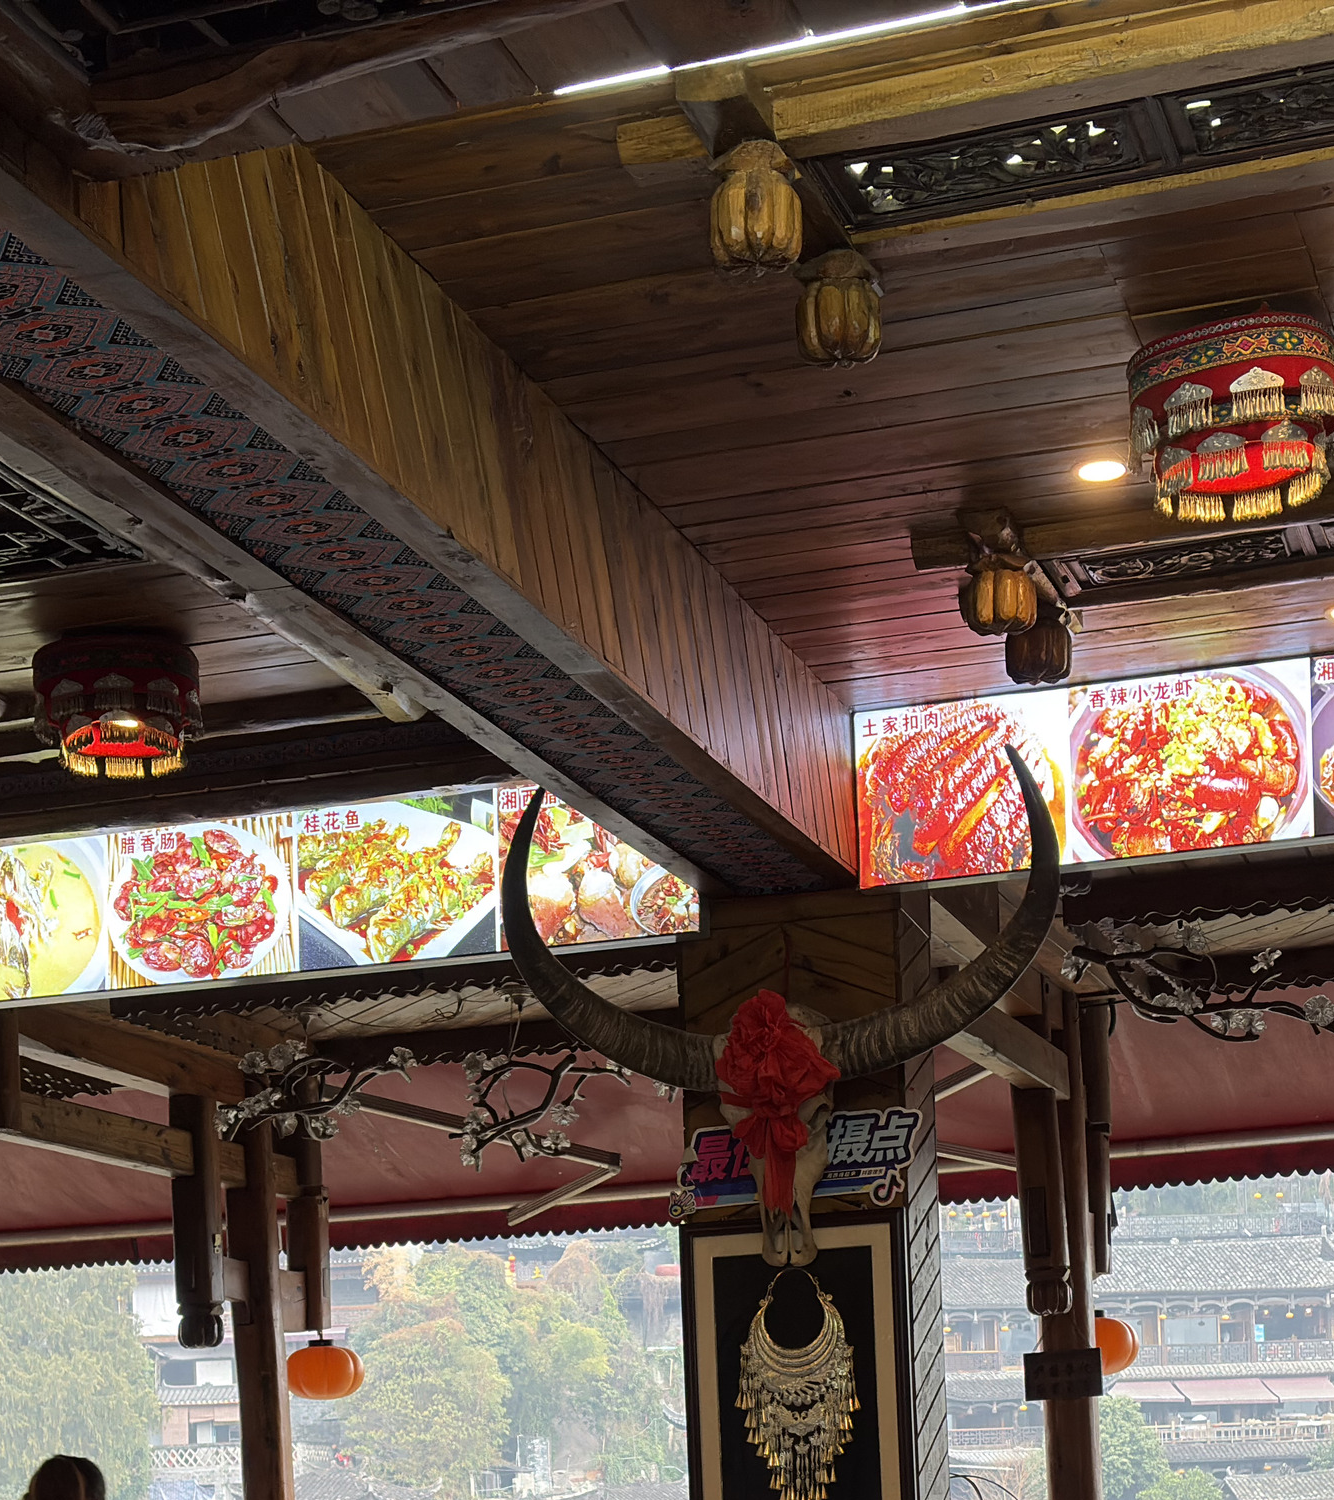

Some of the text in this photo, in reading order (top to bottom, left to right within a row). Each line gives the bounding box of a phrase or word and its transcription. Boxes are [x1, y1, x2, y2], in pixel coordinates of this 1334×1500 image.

[1089, 679, 1194, 709] 香辣小龙虾
[862, 711, 942, 739] 土家扣肉
[304, 809, 361, 834] 桂花鱼
[120, 833, 177, 855] 腊香肠
